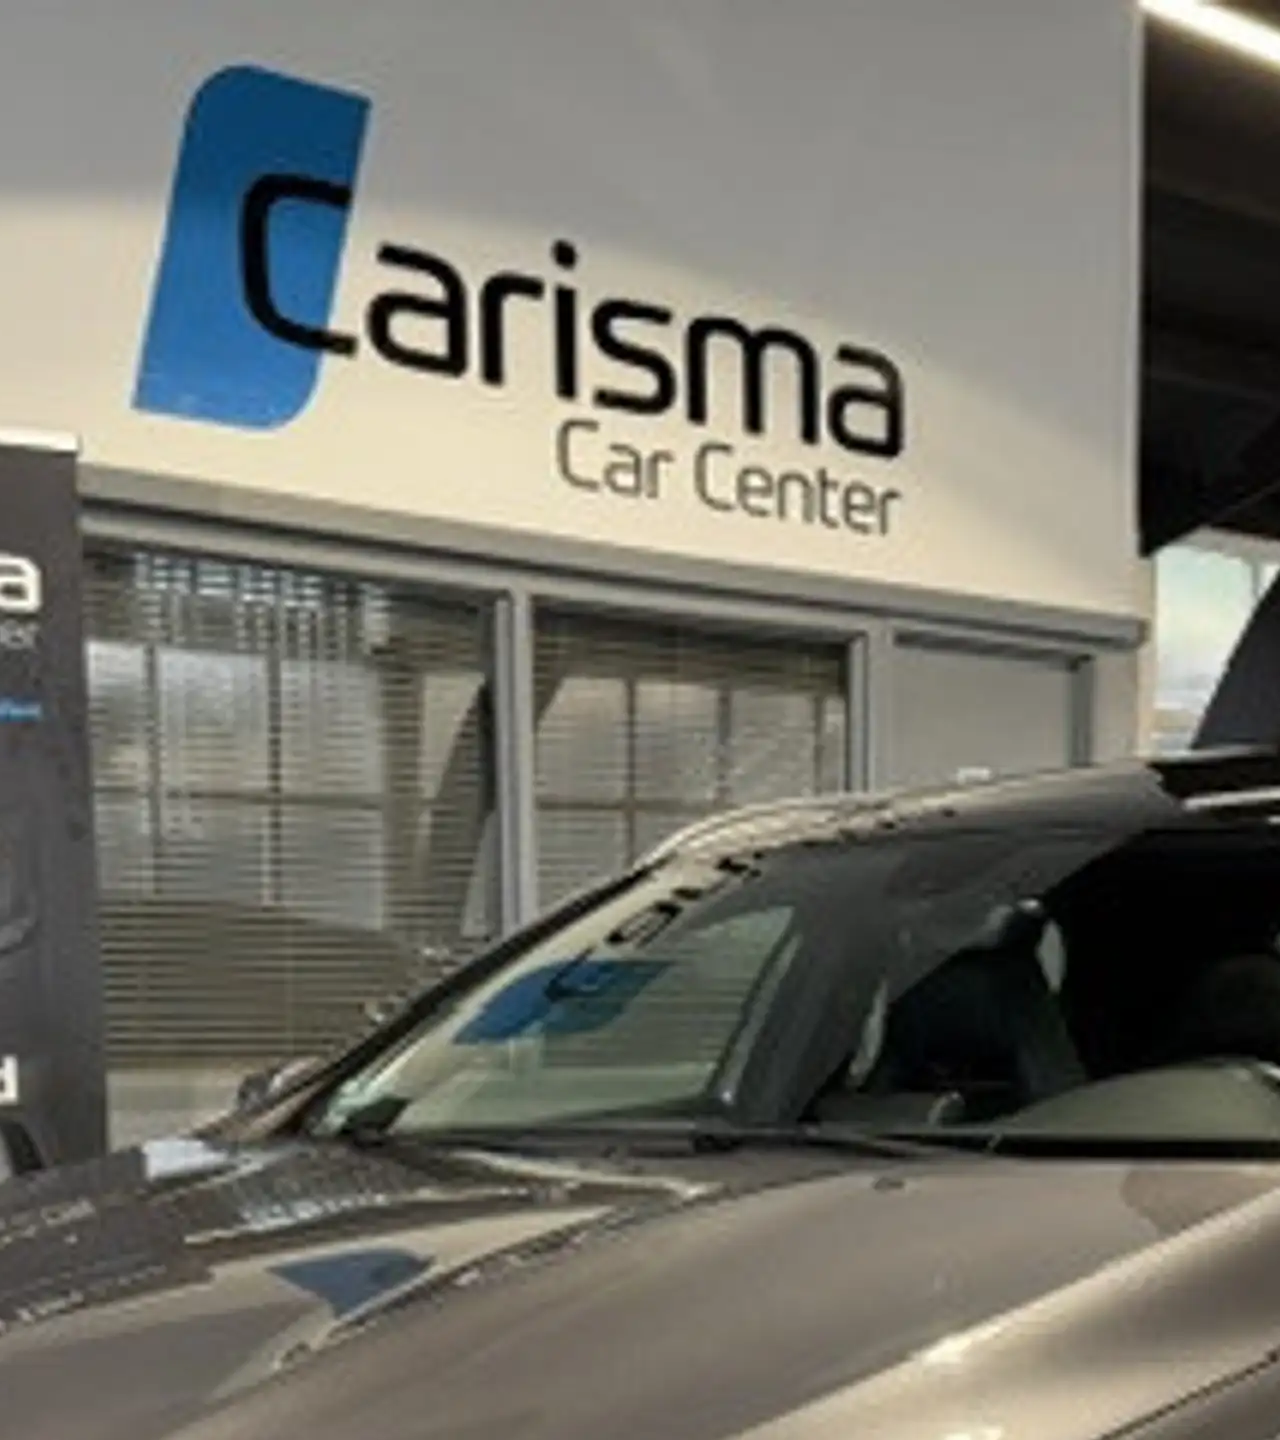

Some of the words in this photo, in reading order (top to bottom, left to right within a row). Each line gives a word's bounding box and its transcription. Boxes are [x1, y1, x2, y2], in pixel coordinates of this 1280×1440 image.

[237, 171, 906, 460] Carisma
[556, 417, 676, 501] Car
[693, 441, 904, 538] Center
